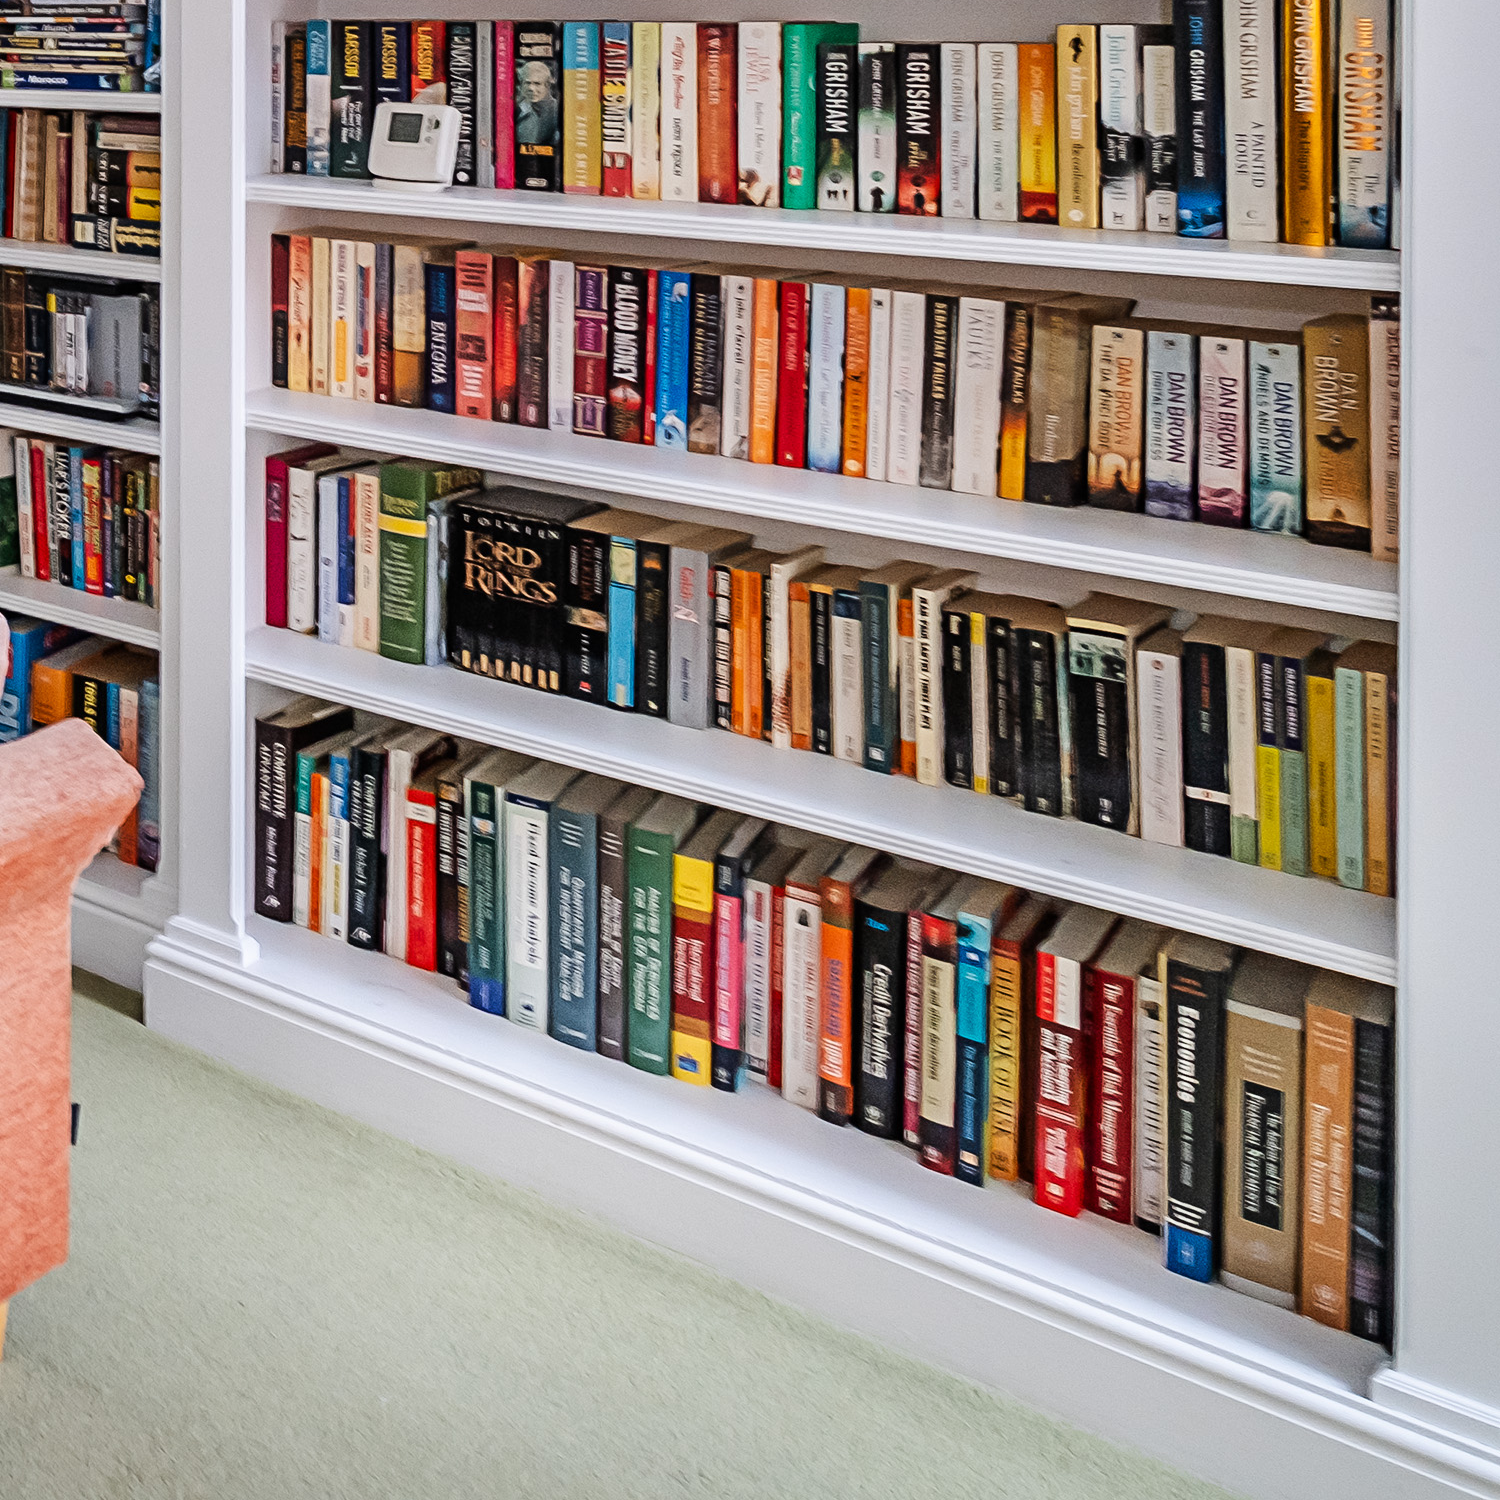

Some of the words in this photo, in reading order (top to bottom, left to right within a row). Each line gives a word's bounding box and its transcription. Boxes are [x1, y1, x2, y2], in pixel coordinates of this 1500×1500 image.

[344, 26, 359, 78] LARSSON
[1107, 34, 1126, 66] John
[1190, 15, 1203, 45] JOHN
[1354, 17, 1375, 48] JOHN
[381, 27, 396, 79] LARSSON
[417, 27, 433, 80] LARSSON
[605, 38, 627, 85] ZADIE
[951, 49, 964, 76] JOHN
[990, 50, 1005, 80] JOHN
[1190, 49, 1205, 101] GRISHAM
[1239, 33, 1258, 99] GRISHAM
[1294, 36, 1315, 113] GRISHAM
[27, 75, 68, 86] Morocco
[824, 61, 848, 133] GRISHAM
[906, 62, 931, 135] GRISHAM
[952, 78, 964, 122] GRISHAM
[1070, 66, 1087, 91] john
[1110, 68, 1126, 123] Grisham
[603, 93, 626, 144] SMITH
[991, 83, 1005, 131] GRISHAM
[1067, 94, 1087, 140] grisham
[1344, 51, 1384, 152] GRISHAM
[993, 139, 1002, 155] THE
[1251, 122, 1265, 130] A
[993, 157, 1002, 192] PARTNER
[1234, 133, 1248, 176] HOUSE
[1251, 133, 1265, 188] PAINTED
[1364, 174, 1379, 194] The
[613, 284, 640, 331] BLOOD
[786, 292, 798, 316] CITY
[786, 318, 797, 331] OF
[430, 320, 447, 384] ENIGMA
[785, 332, 797, 370] WOMEN
[932, 302, 948, 359] SEBASTIAN
[613, 332, 639, 384] MONEY
[932, 361, 947, 399] FAULKS
[1117, 357, 1133, 389] DAN
[1167, 371, 1186, 404] DAN
[1218, 376, 1238, 409] DAN
[1255, 363, 1273, 407] ANGELS
[1273, 382, 1294, 414] DAN
[1312, 355, 1340, 424] BROWN
[1340, 372, 1359, 410] DAN
[1042, 414, 1059, 463] Birdsong
[1114, 390, 1133, 446] BROWN
[1166, 406, 1186, 464] BROWN
[1256, 410, 1272, 434] AND
[1217, 411, 1238, 470] BROWN
[1255, 437, 1272, 486] DEMONS
[1272, 417, 1294, 477] BROWN
[55, 450, 70, 490] LIAR'S
[56, 492, 68, 540] POKER
[463, 530, 543, 570] LORD
[462, 560, 559, 605] RINGS
[83, 681, 97, 715] TOOLS
[1284, 667, 1297, 704] GRAHAM
[1285, 706, 1298, 739] GREENE
[257, 743, 271, 813] ADVANTAGE
[271, 742, 287, 820] COMPETITIVE
[362, 774, 376, 840] COMPETITIVE
[525, 822, 542, 859] Fixed
[525, 861, 542, 909] Income
[570, 876, 585, 947] QUANTITATIVE
[525, 910, 542, 965] Analysis
[571, 949, 584, 999] METHODS
[871, 964, 893, 1004] Credit
[994, 966, 1012, 1000] THE
[1103, 984, 1123, 1003] The
[871, 1005, 891, 1079] Derivatives
[992, 1005, 1013, 1064] BOOK
[1101, 1005, 1122, 1055] Essentials
[1101, 1058, 1121, 1069] of
[1176, 1004, 1200, 1103] Economics
[992, 1067, 1010, 1091] OF
[1101, 1070, 1122, 1096] Risk
[991, 1096, 1012, 1137] RISK
[1099, 1098, 1119, 1166] Management
[1245, 1091, 1266, 1146] FINANCIAL
[1266, 1112, 1282, 1129] The
[1264, 1129, 1282, 1162] Analysis
[1244, 1148, 1264, 1214] STATEMENTS
[1264, 1179, 1281, 1194] Use
[1265, 1163, 1282, 1179] and
[1265, 1194, 1282, 1208] of
